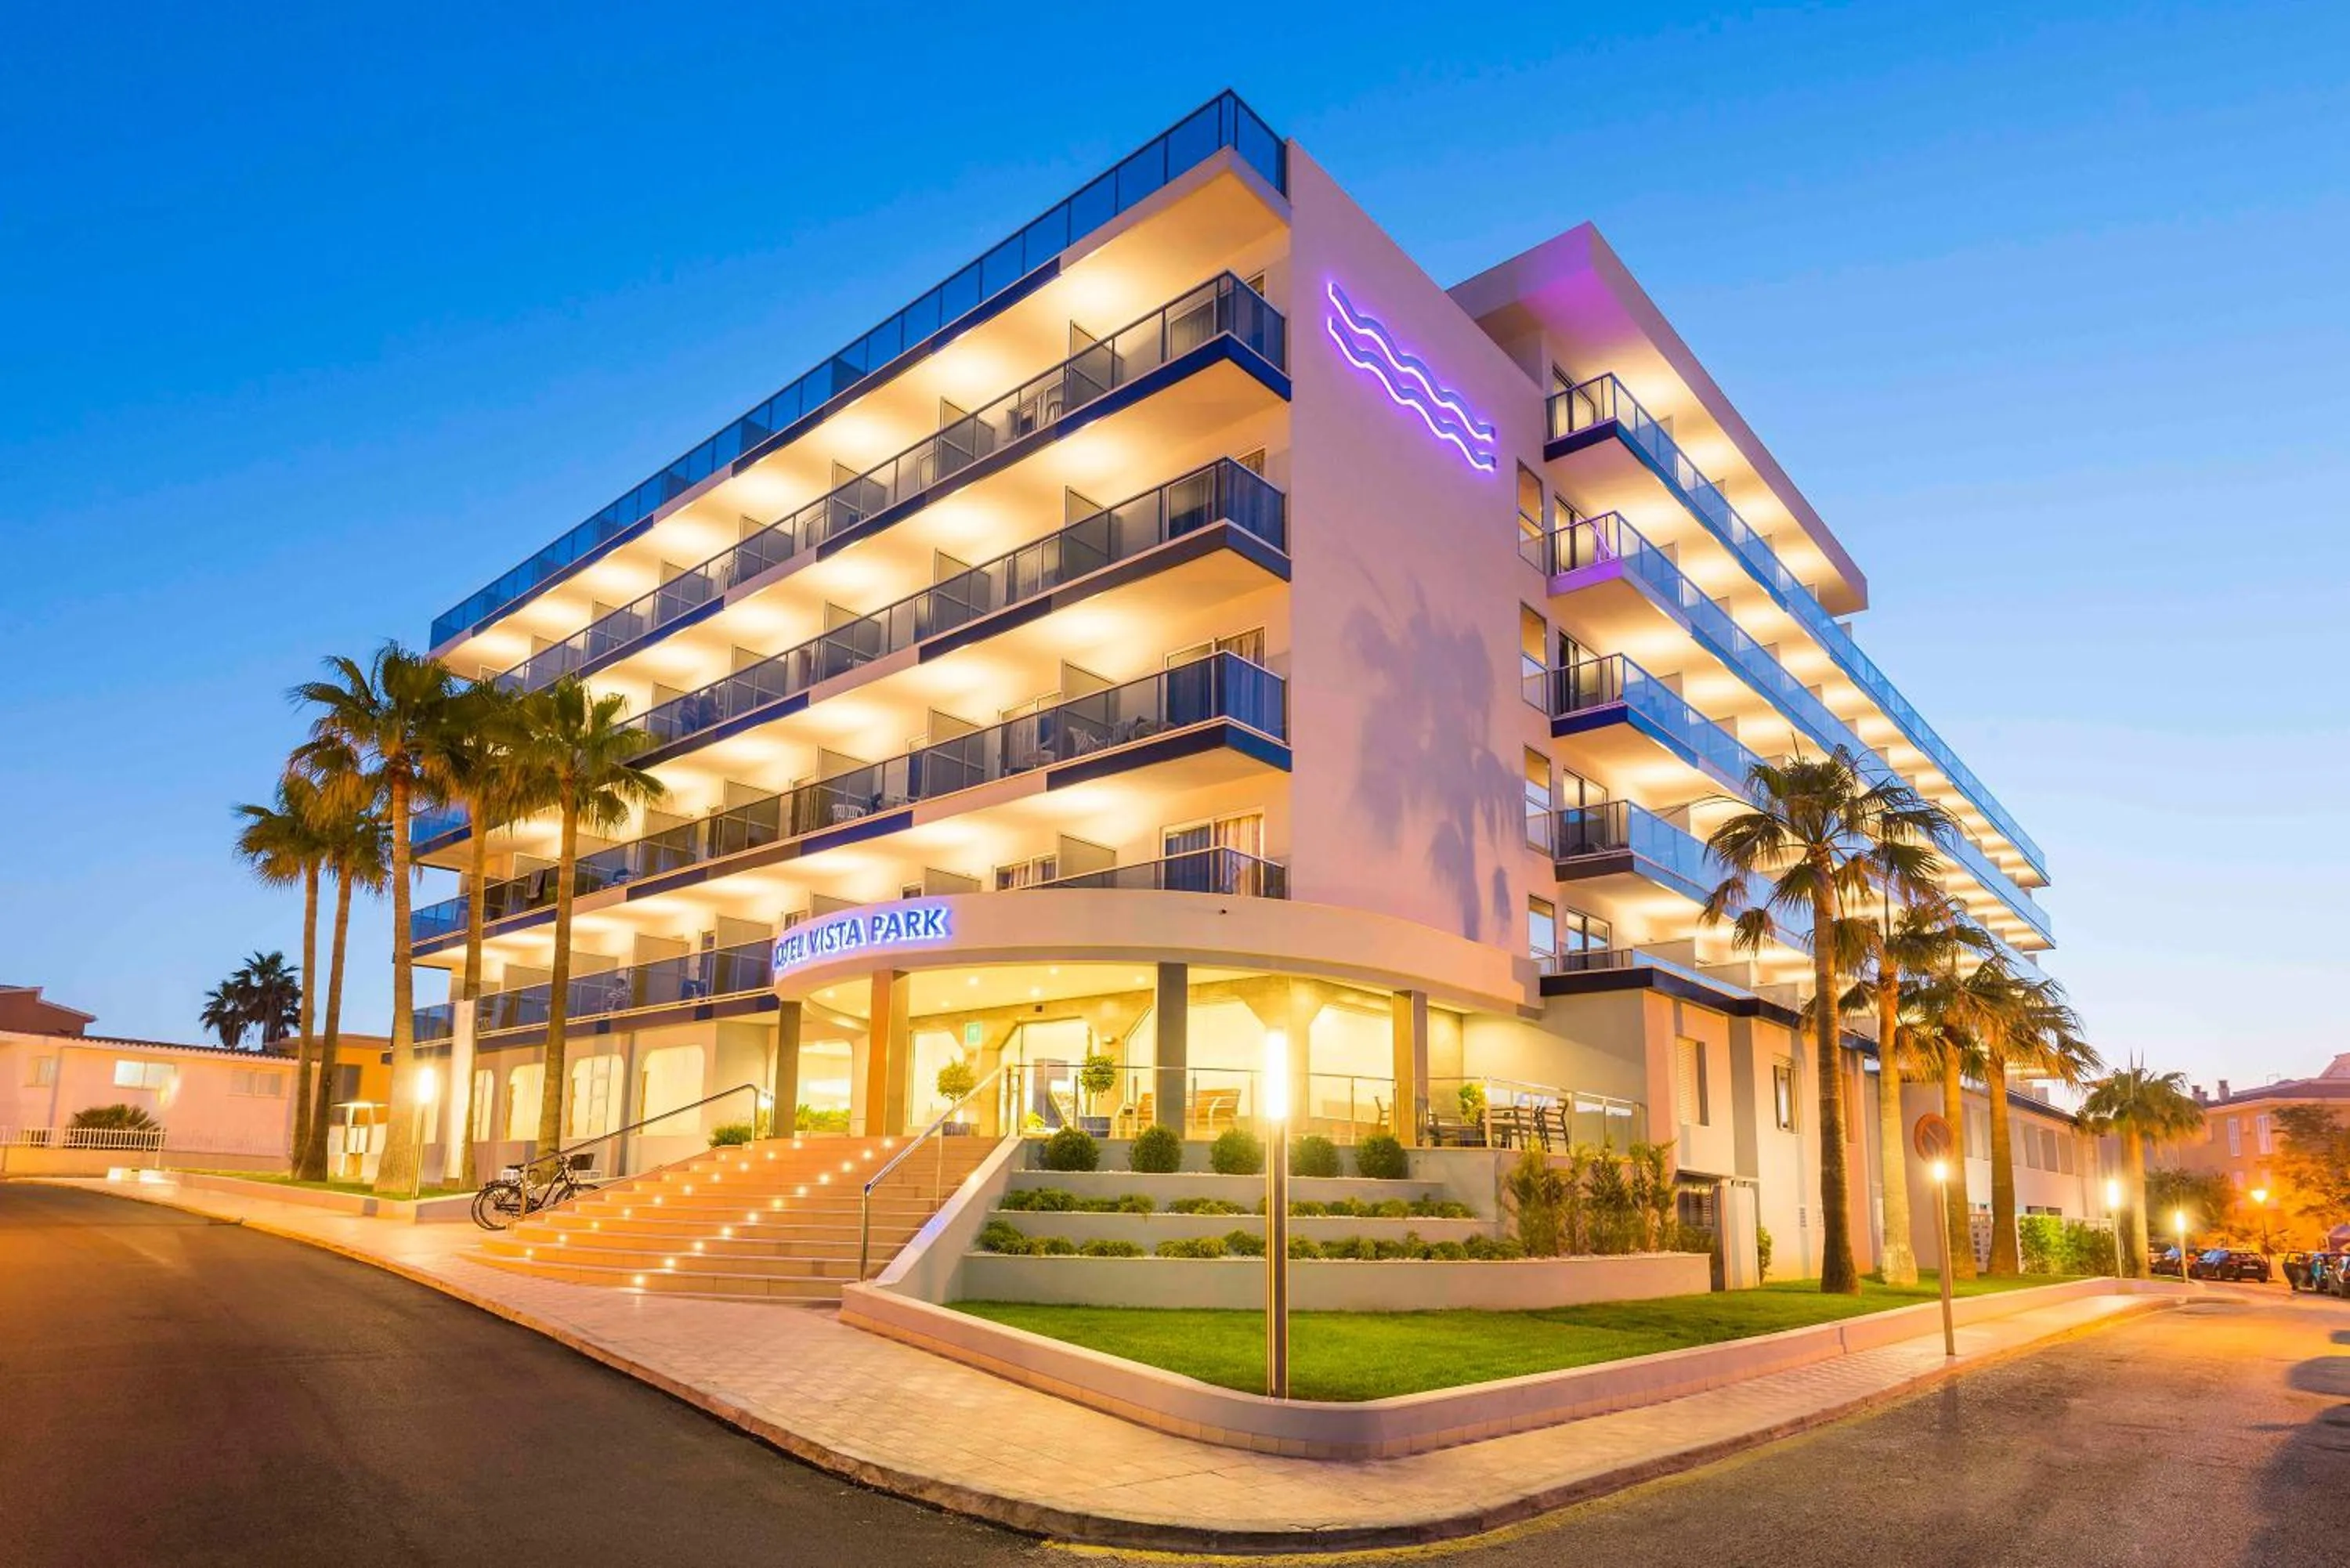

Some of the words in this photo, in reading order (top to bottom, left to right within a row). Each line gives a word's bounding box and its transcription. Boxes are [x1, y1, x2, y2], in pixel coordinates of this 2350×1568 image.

[774, 934, 806, 968] OTEL
[809, 918, 863, 954] VISTA
[871, 909, 945, 942] PARK
